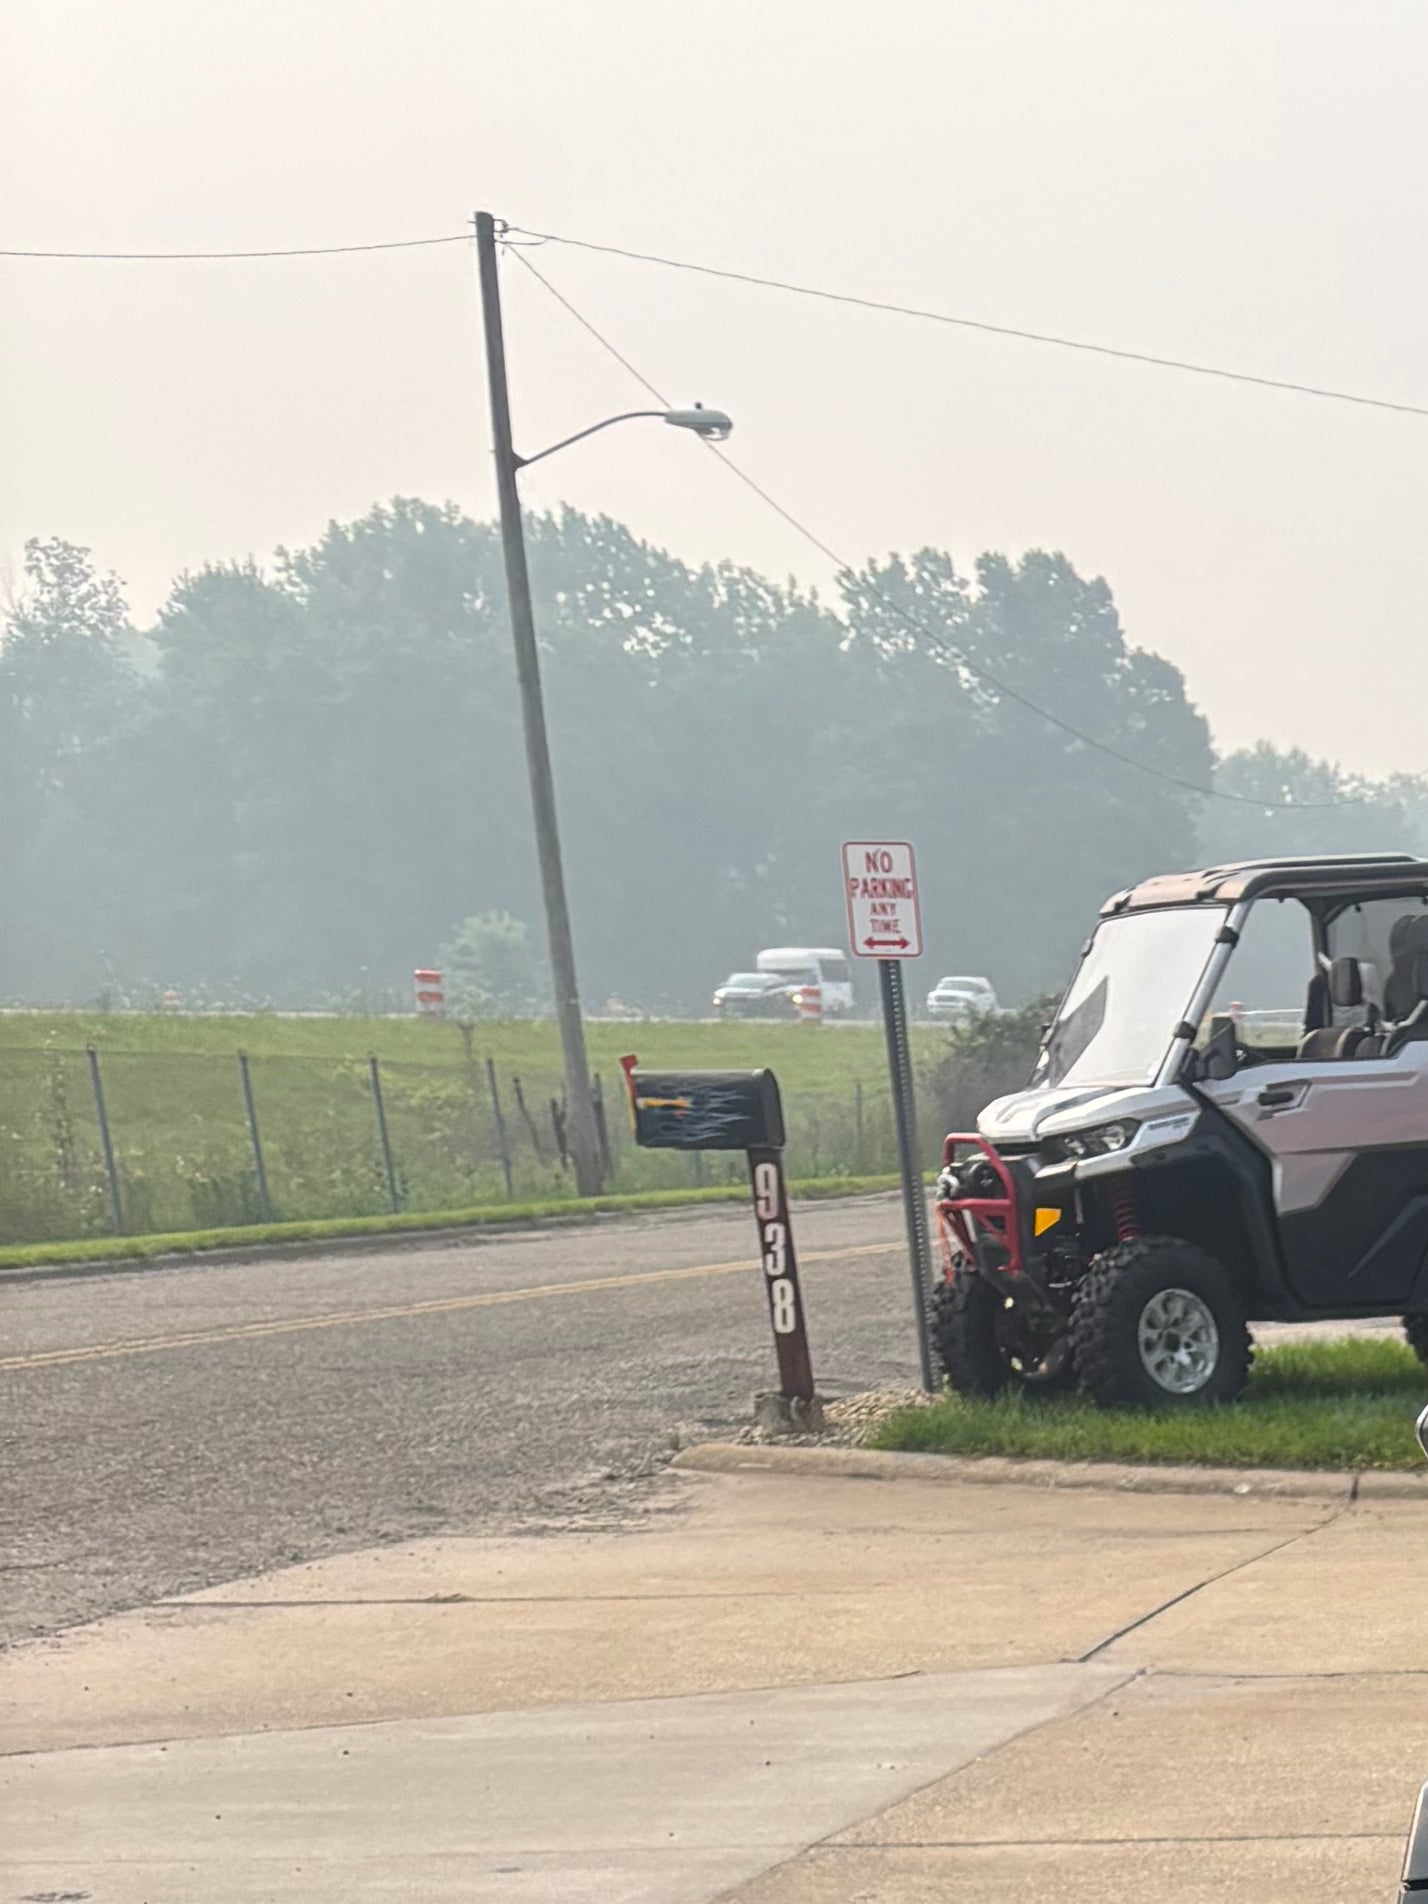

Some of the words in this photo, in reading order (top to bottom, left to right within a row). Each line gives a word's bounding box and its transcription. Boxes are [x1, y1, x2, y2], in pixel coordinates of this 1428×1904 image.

[865, 850, 893, 873] NO
[848, 877, 912, 899] PARKING
[870, 902, 897, 916] ANY
[870, 918, 901, 934] TIME
[755, 1163, 796, 1334] 938
